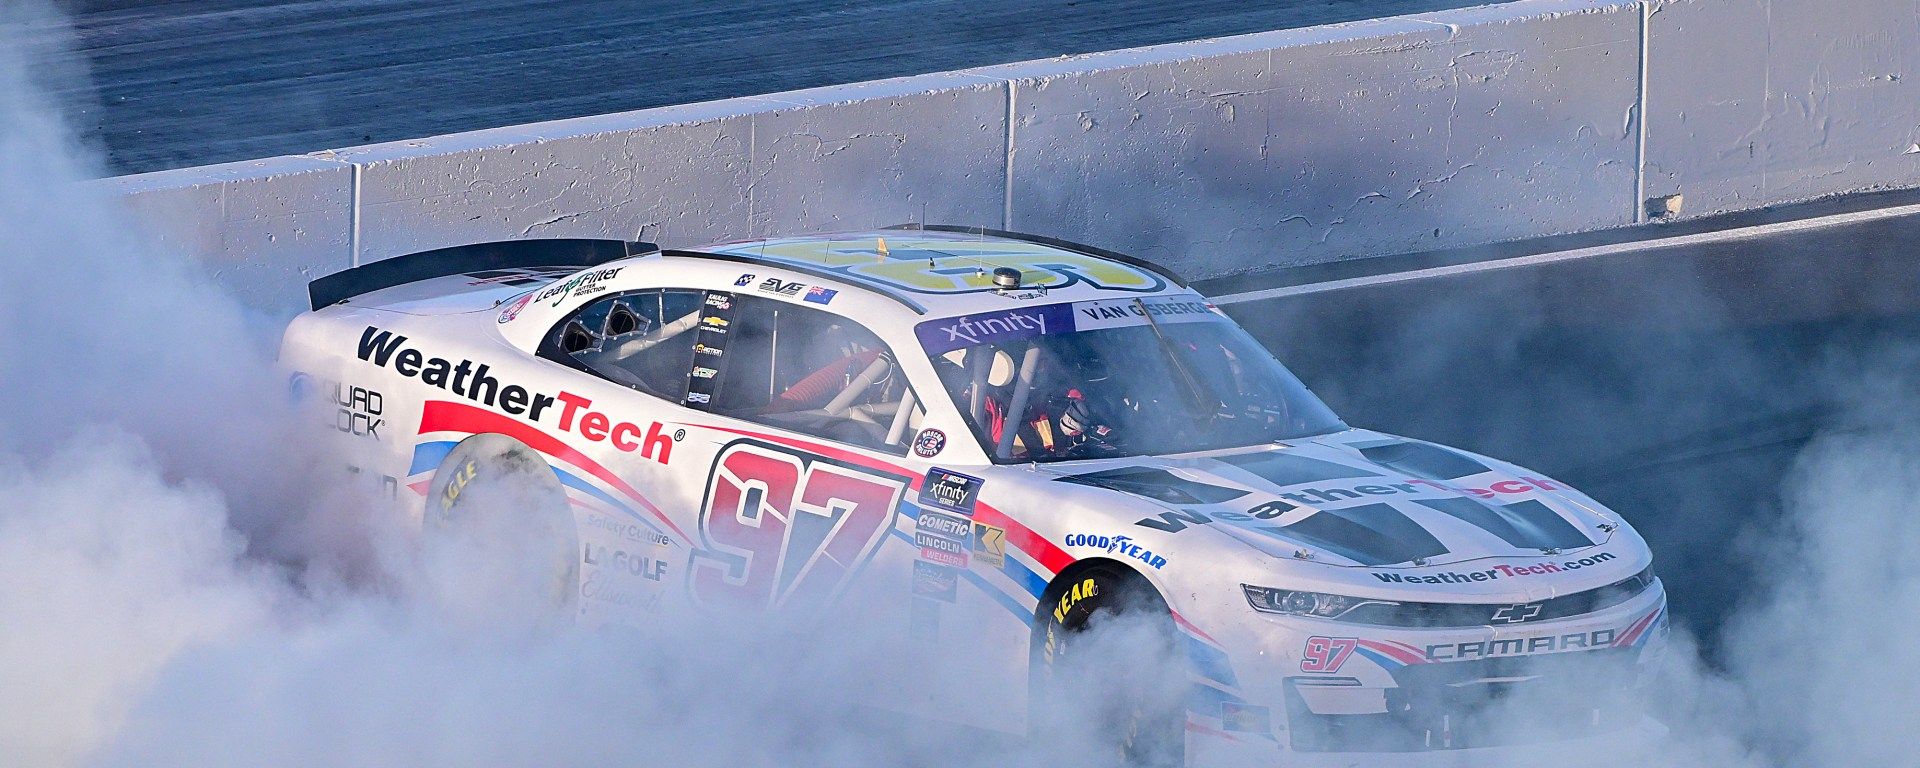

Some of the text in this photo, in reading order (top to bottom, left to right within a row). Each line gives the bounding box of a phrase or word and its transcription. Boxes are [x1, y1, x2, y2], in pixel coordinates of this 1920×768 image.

[573, 285, 606, 298] PROTECTION
[759, 278, 807, 295] SVG
[1082, 306, 1129, 320] VAN
[939, 312, 1047, 344] xfinity
[331, 381, 383, 416] UAD
[930, 481, 969, 505] xfinity
[938, 497, 956, 507] SERIES
[685, 437, 913, 608] 97
[918, 514, 969, 536] COMETIC
[917, 534, 960, 553] LINCOLN
[1065, 533, 1168, 570] GOODYEAR
[613, 550, 668, 581] GOLF
[926, 549, 963, 567] WELDERS
[1300, 636, 1359, 673] 97
[1425, 628, 1615, 660] CAMARO
